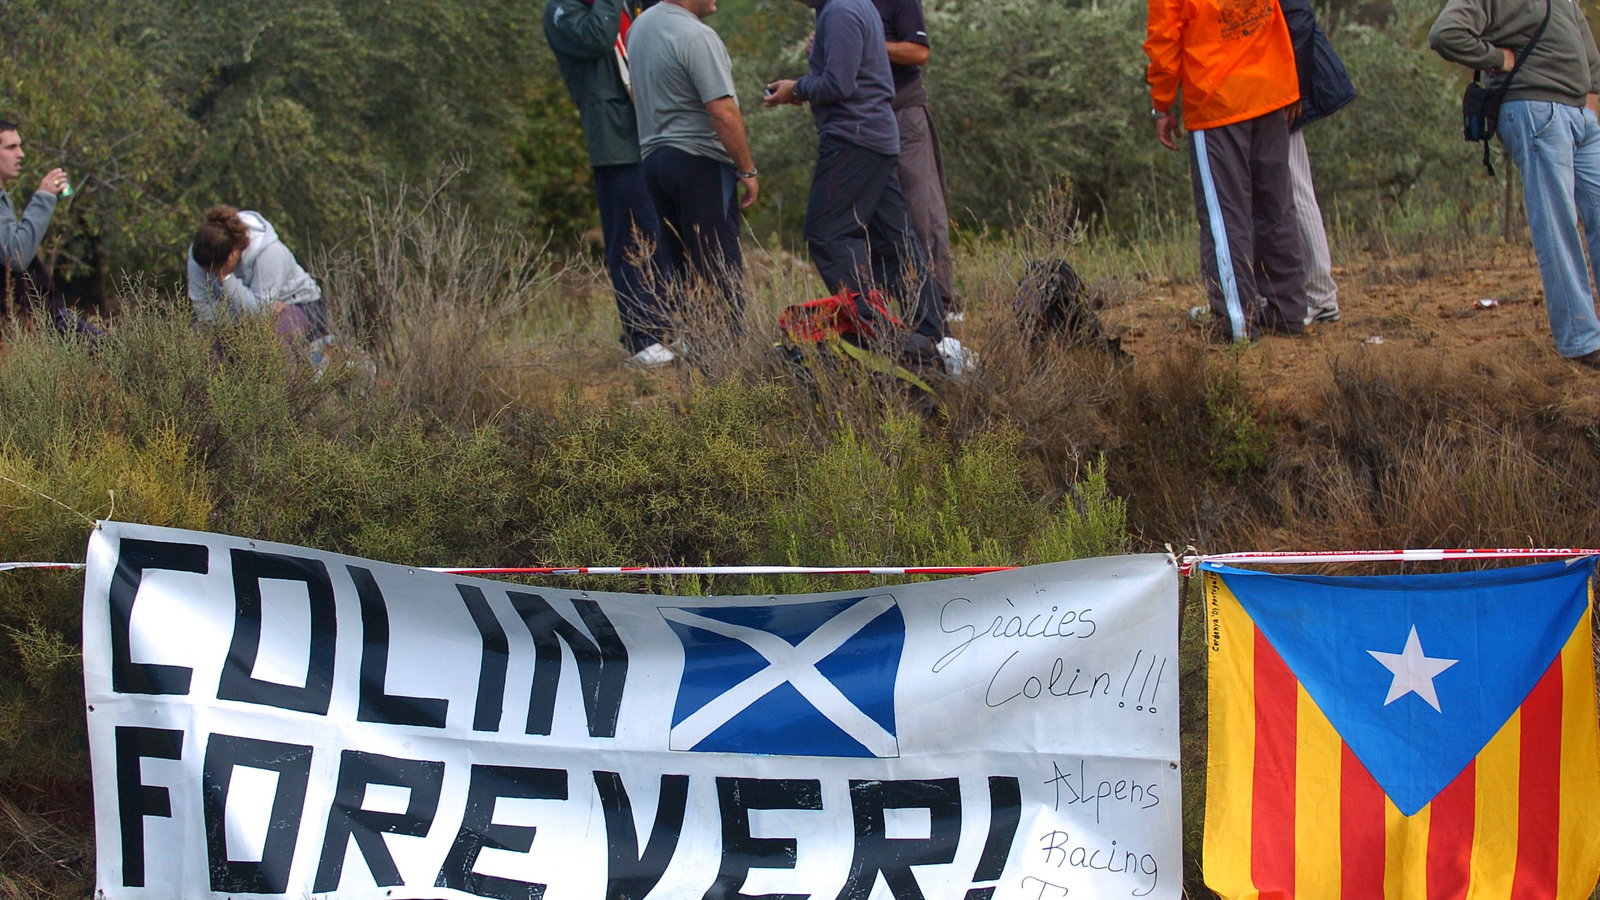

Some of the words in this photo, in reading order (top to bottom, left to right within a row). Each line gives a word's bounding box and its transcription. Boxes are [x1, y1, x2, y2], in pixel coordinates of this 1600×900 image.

[111, 538, 629, 737] COLIN
[932, 598, 1097, 672] Gràcies
[985, 649, 1166, 714] Colin!!!
[115, 726, 1021, 900] FOREVER!
[1040, 830, 1158, 896] Racing
